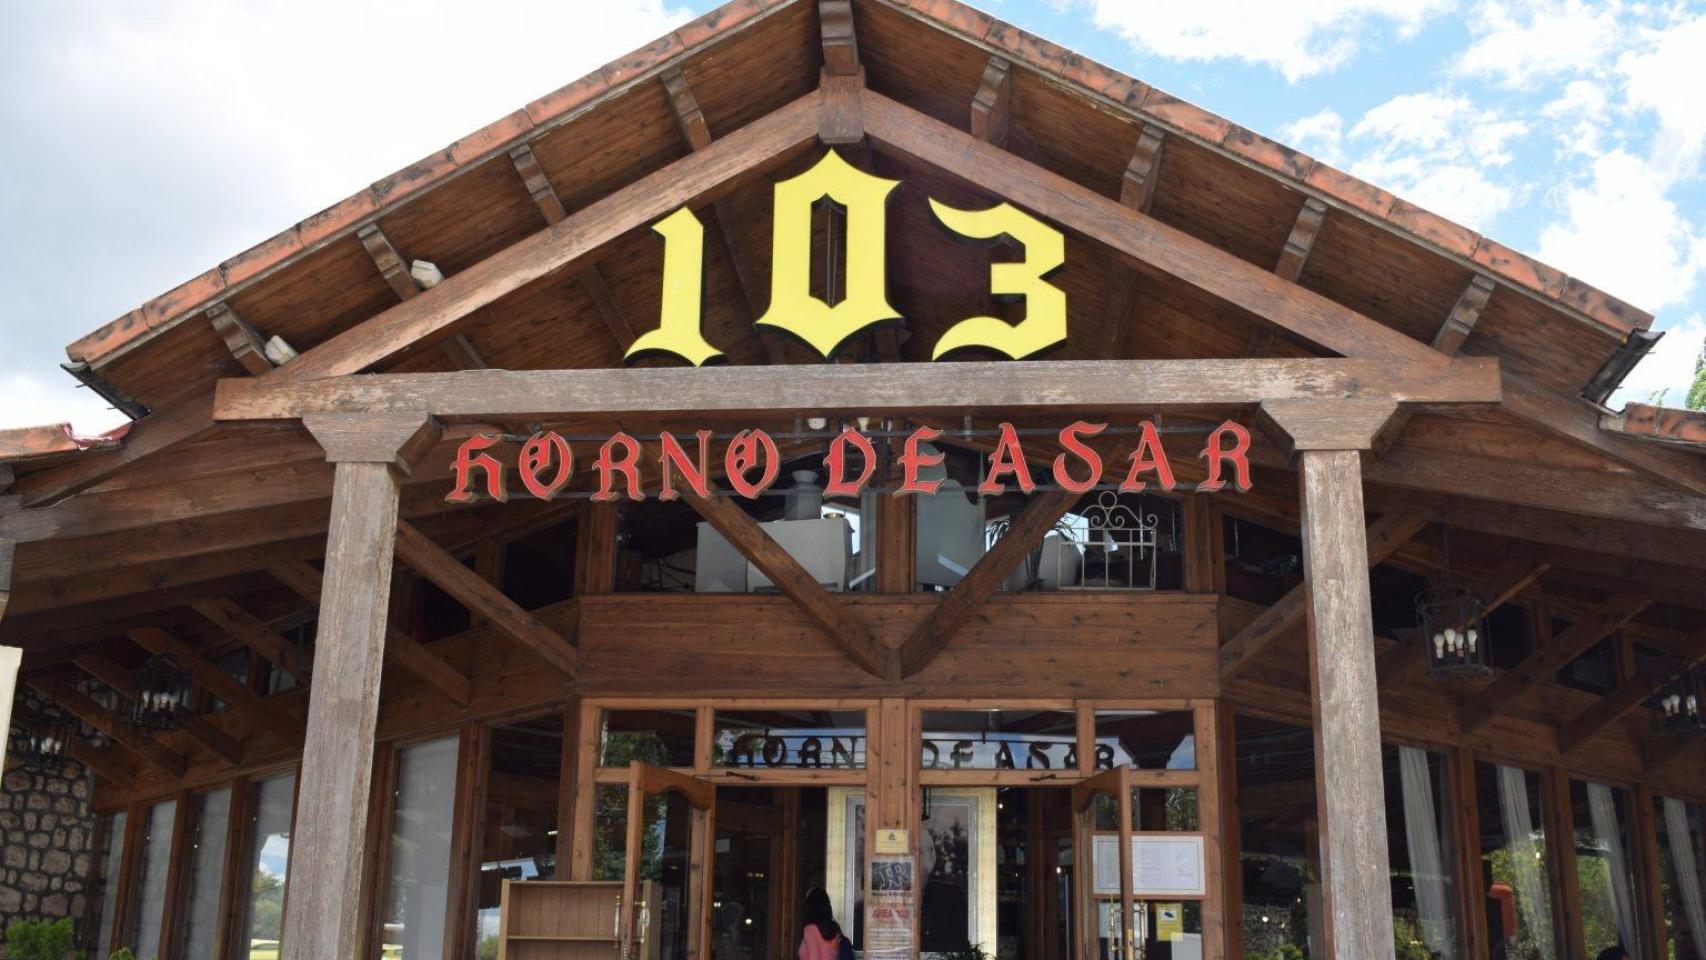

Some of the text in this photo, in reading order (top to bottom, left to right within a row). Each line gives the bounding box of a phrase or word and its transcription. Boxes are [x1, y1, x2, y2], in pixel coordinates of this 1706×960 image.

[623, 148, 1067, 367] 103
[445, 419, 1253, 502] HORNO DE ASAR
